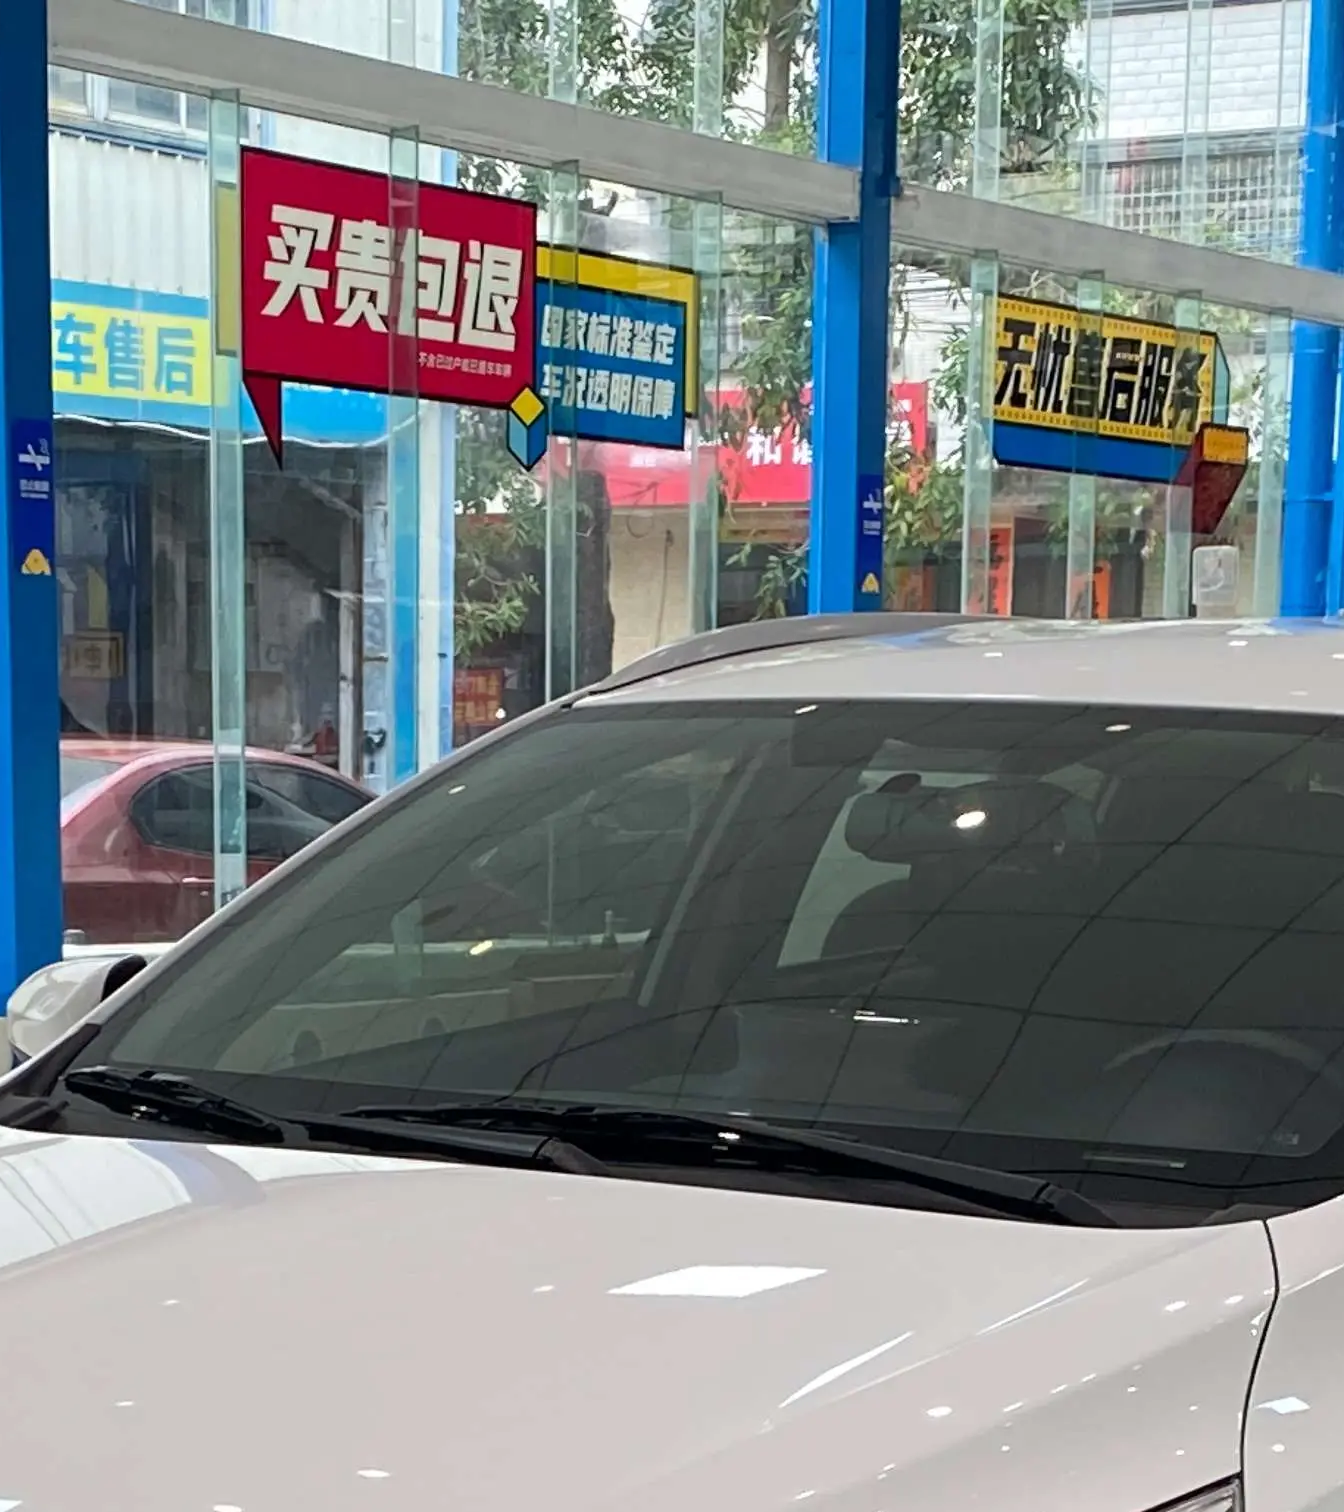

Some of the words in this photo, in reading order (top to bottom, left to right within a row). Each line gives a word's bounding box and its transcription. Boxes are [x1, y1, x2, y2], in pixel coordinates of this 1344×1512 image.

[260, 204, 523, 352] 买贵包退
[541, 304, 677, 366] 国家标准鉴定
[994, 316, 1208, 430] 无忧售后服务
[540, 363, 676, 420] 车况透明保障
